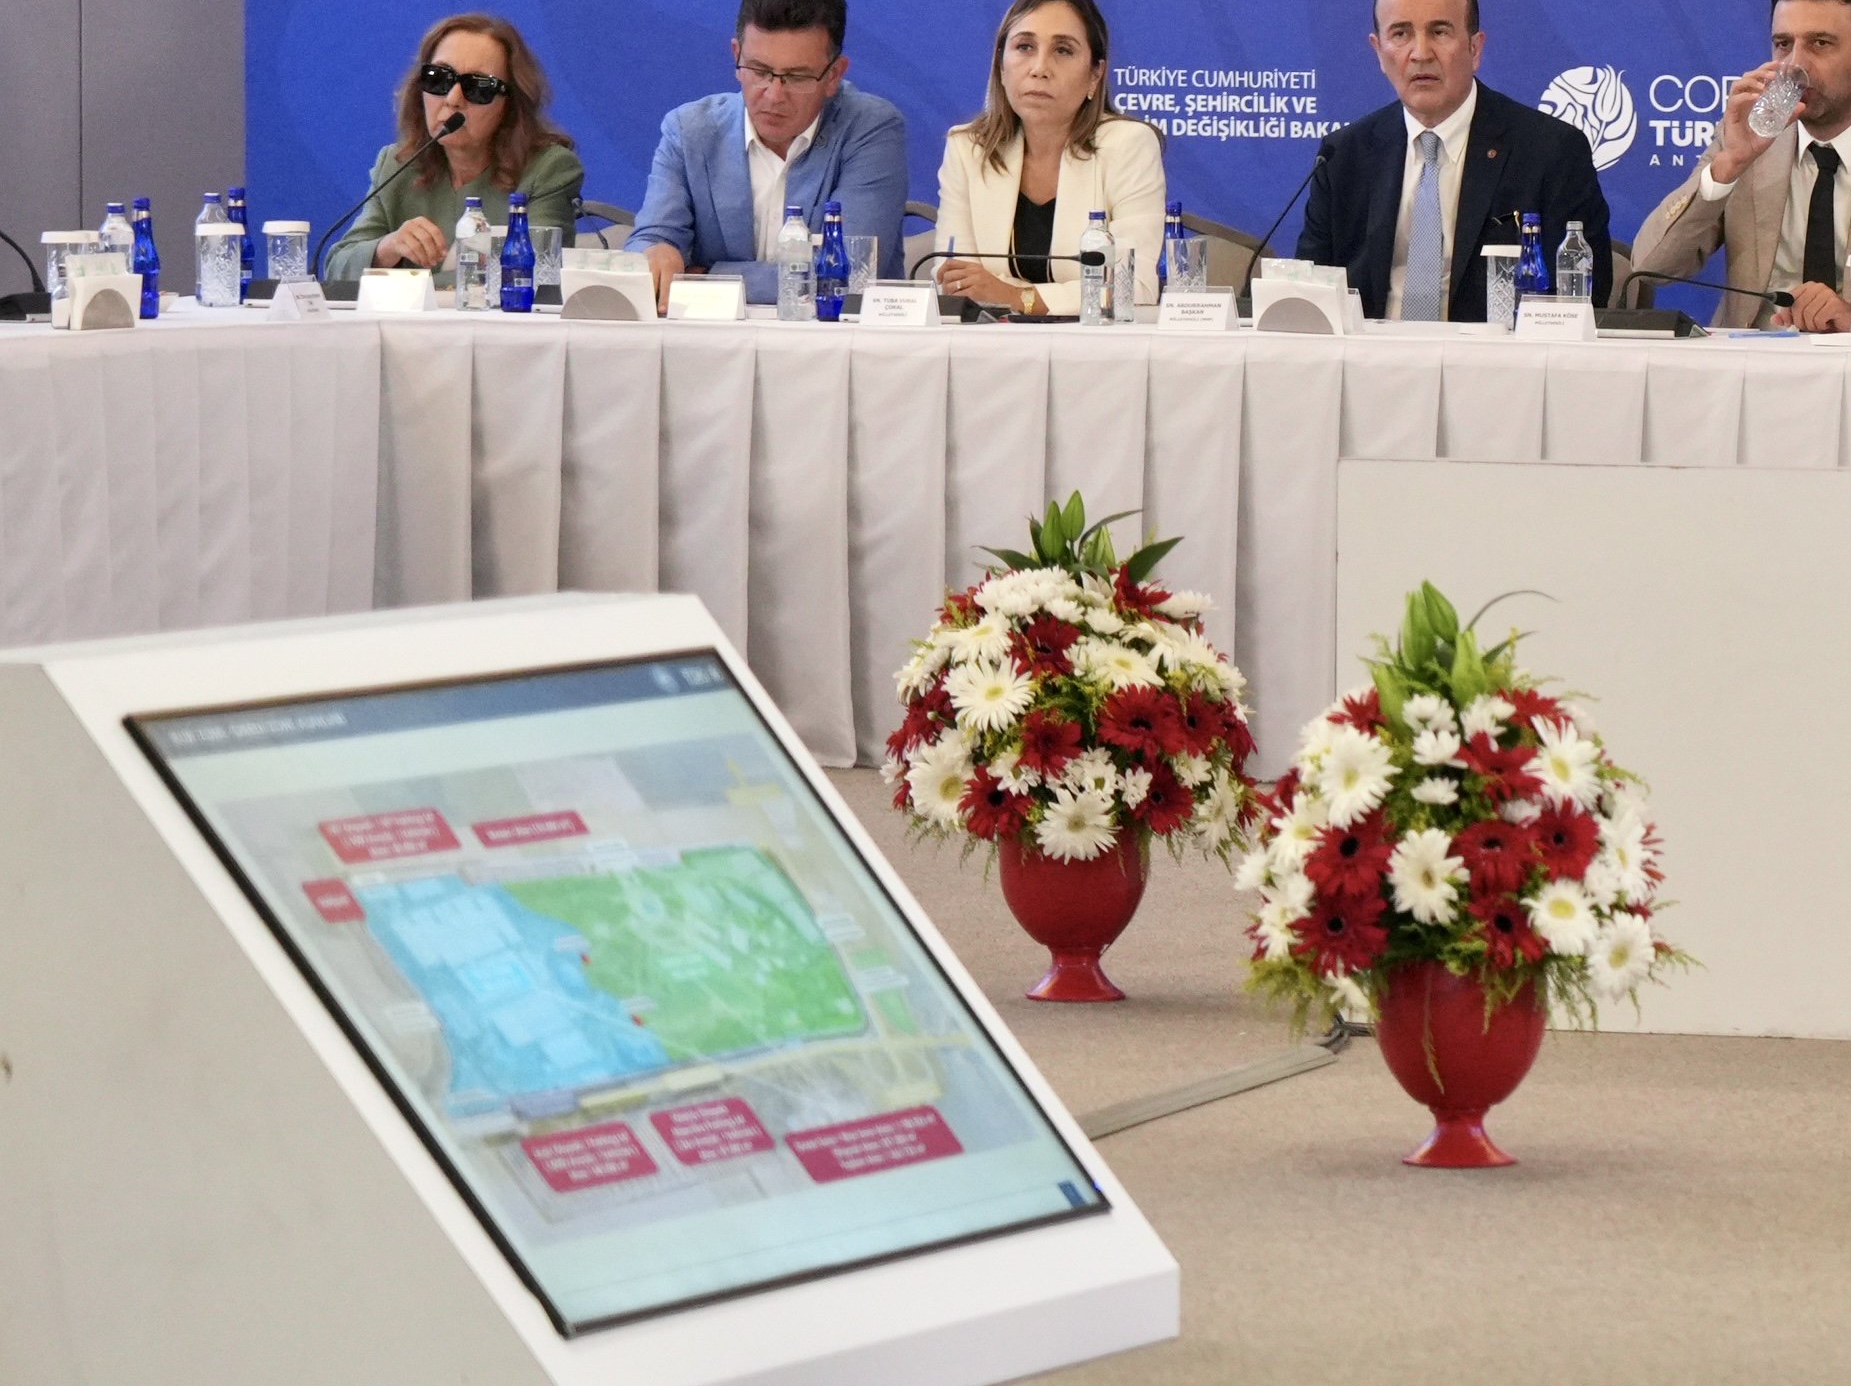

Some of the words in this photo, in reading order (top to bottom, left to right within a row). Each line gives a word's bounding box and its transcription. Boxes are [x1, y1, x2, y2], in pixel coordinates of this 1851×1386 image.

[1114, 66, 1187, 86] TÜRKİYE
[1192, 69, 1315, 88] CUMHURİYETİ
[1114, 94, 1180, 114] ÇEVRE,
[1185, 92, 1288, 116] ŞEHİRCİLİK
[1292, 97, 1316, 113] VE
[1173, 116, 1285, 141] DEĞİŞİKLİĞİ
